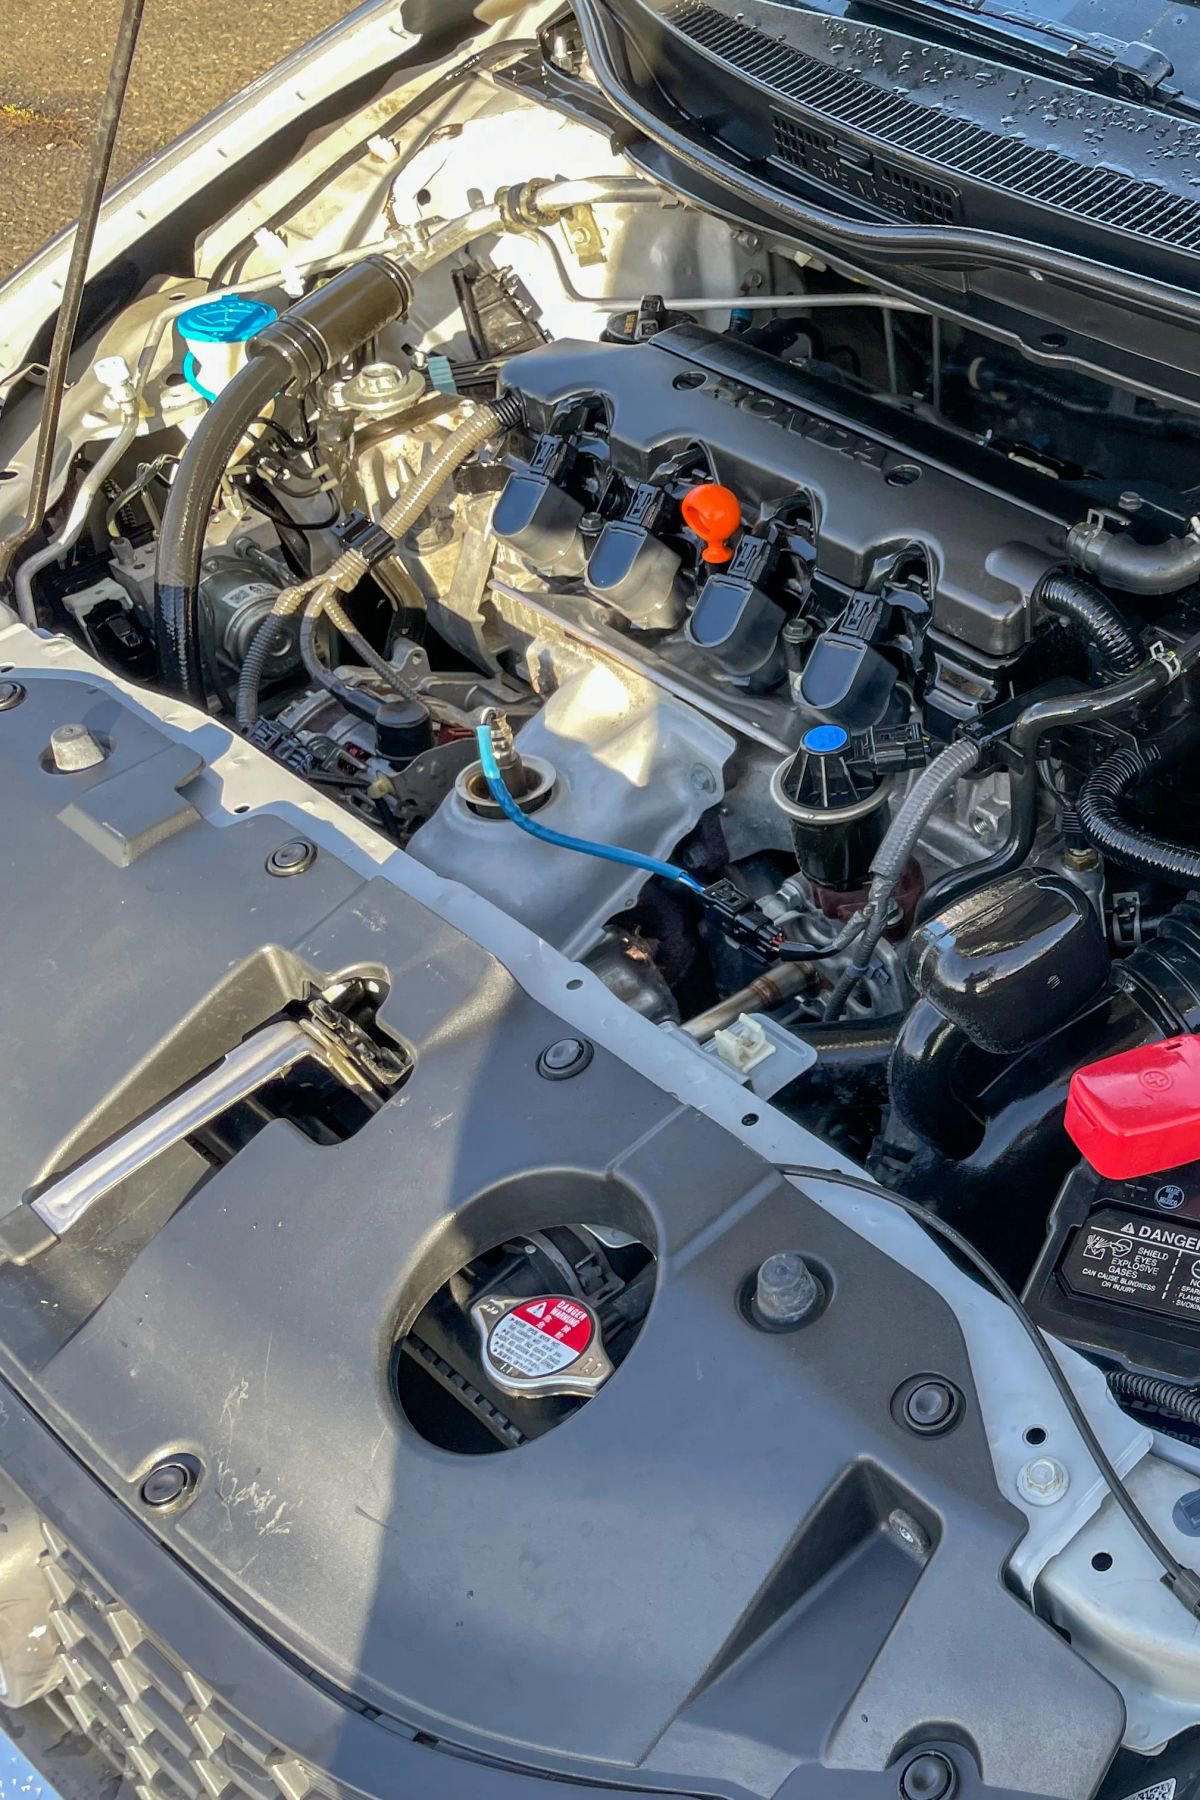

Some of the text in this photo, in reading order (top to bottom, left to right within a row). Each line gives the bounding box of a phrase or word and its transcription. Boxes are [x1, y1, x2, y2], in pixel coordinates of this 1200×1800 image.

[1134, 1255, 1158, 1267] EYES
[1137, 1247, 1169, 1261] SHIELD
[1108, 1266, 1138, 1279] GASES
[1111, 1257, 1160, 1275] EXPLOSIVE
[1082, 1268, 1157, 1292] CAN CAUSE BLINDNESS
[1112, 1283, 1136, 1294] INJURY
[556, 1300, 588, 1321] DANGER
